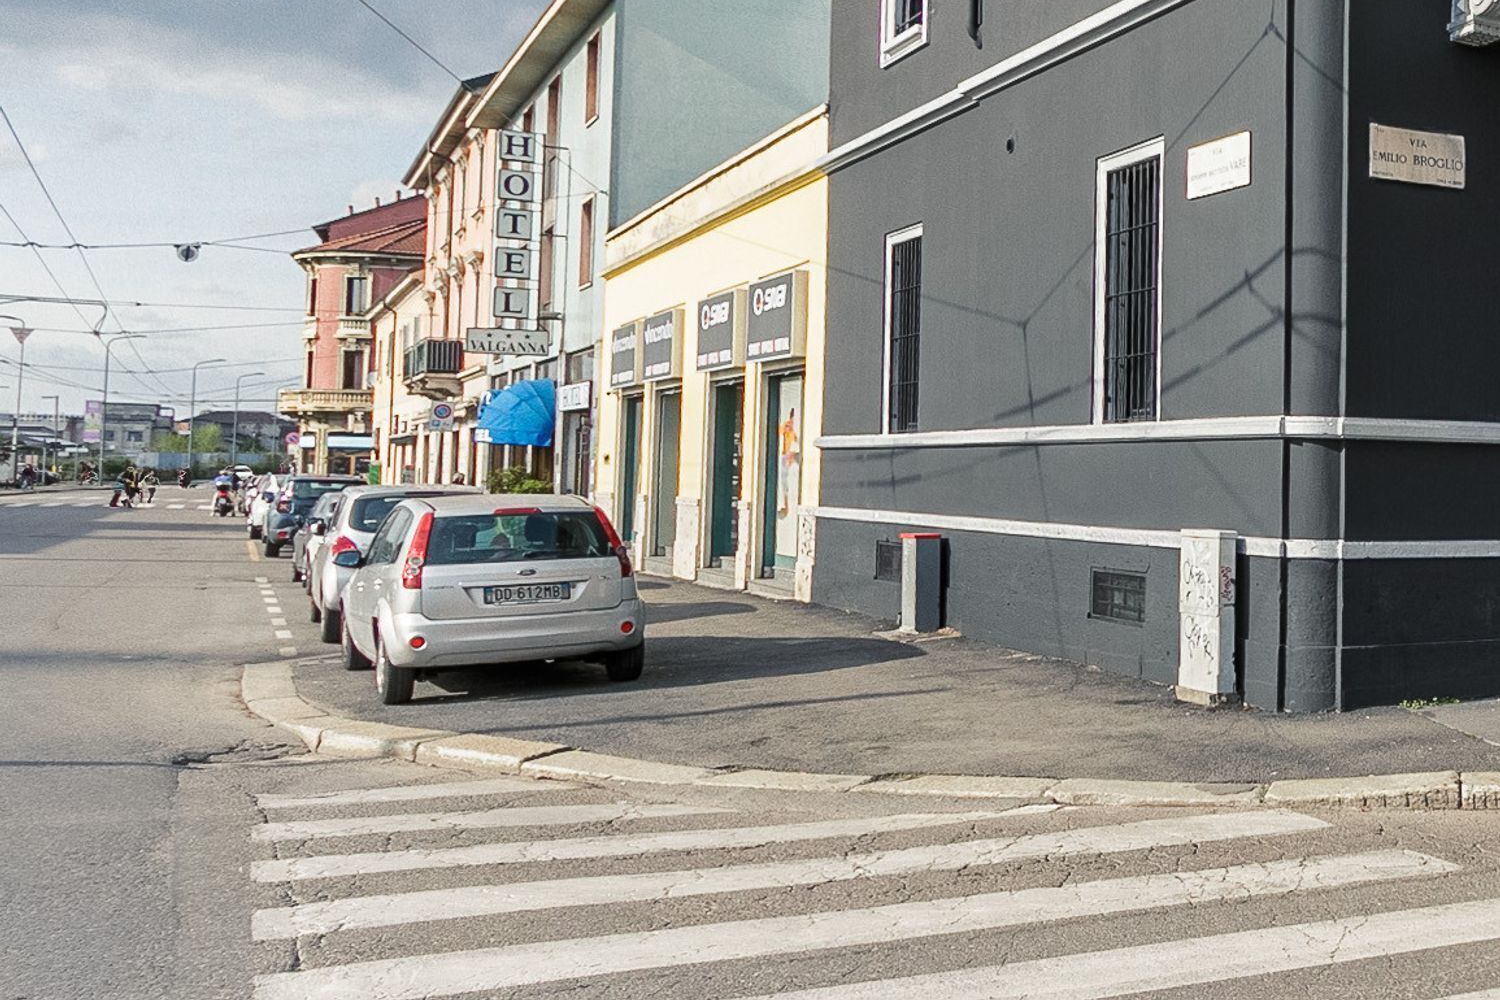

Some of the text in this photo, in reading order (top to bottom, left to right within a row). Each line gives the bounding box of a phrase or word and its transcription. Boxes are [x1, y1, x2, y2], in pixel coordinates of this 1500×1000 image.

[1409, 138, 1428, 149] VIA
[1373, 151, 1464, 172] EMILIO BROGLIO
[503, 134, 532, 314] HOTEL
[470, 339, 546, 354] VALGANNA
[516, 585, 561, 600] 612MB
